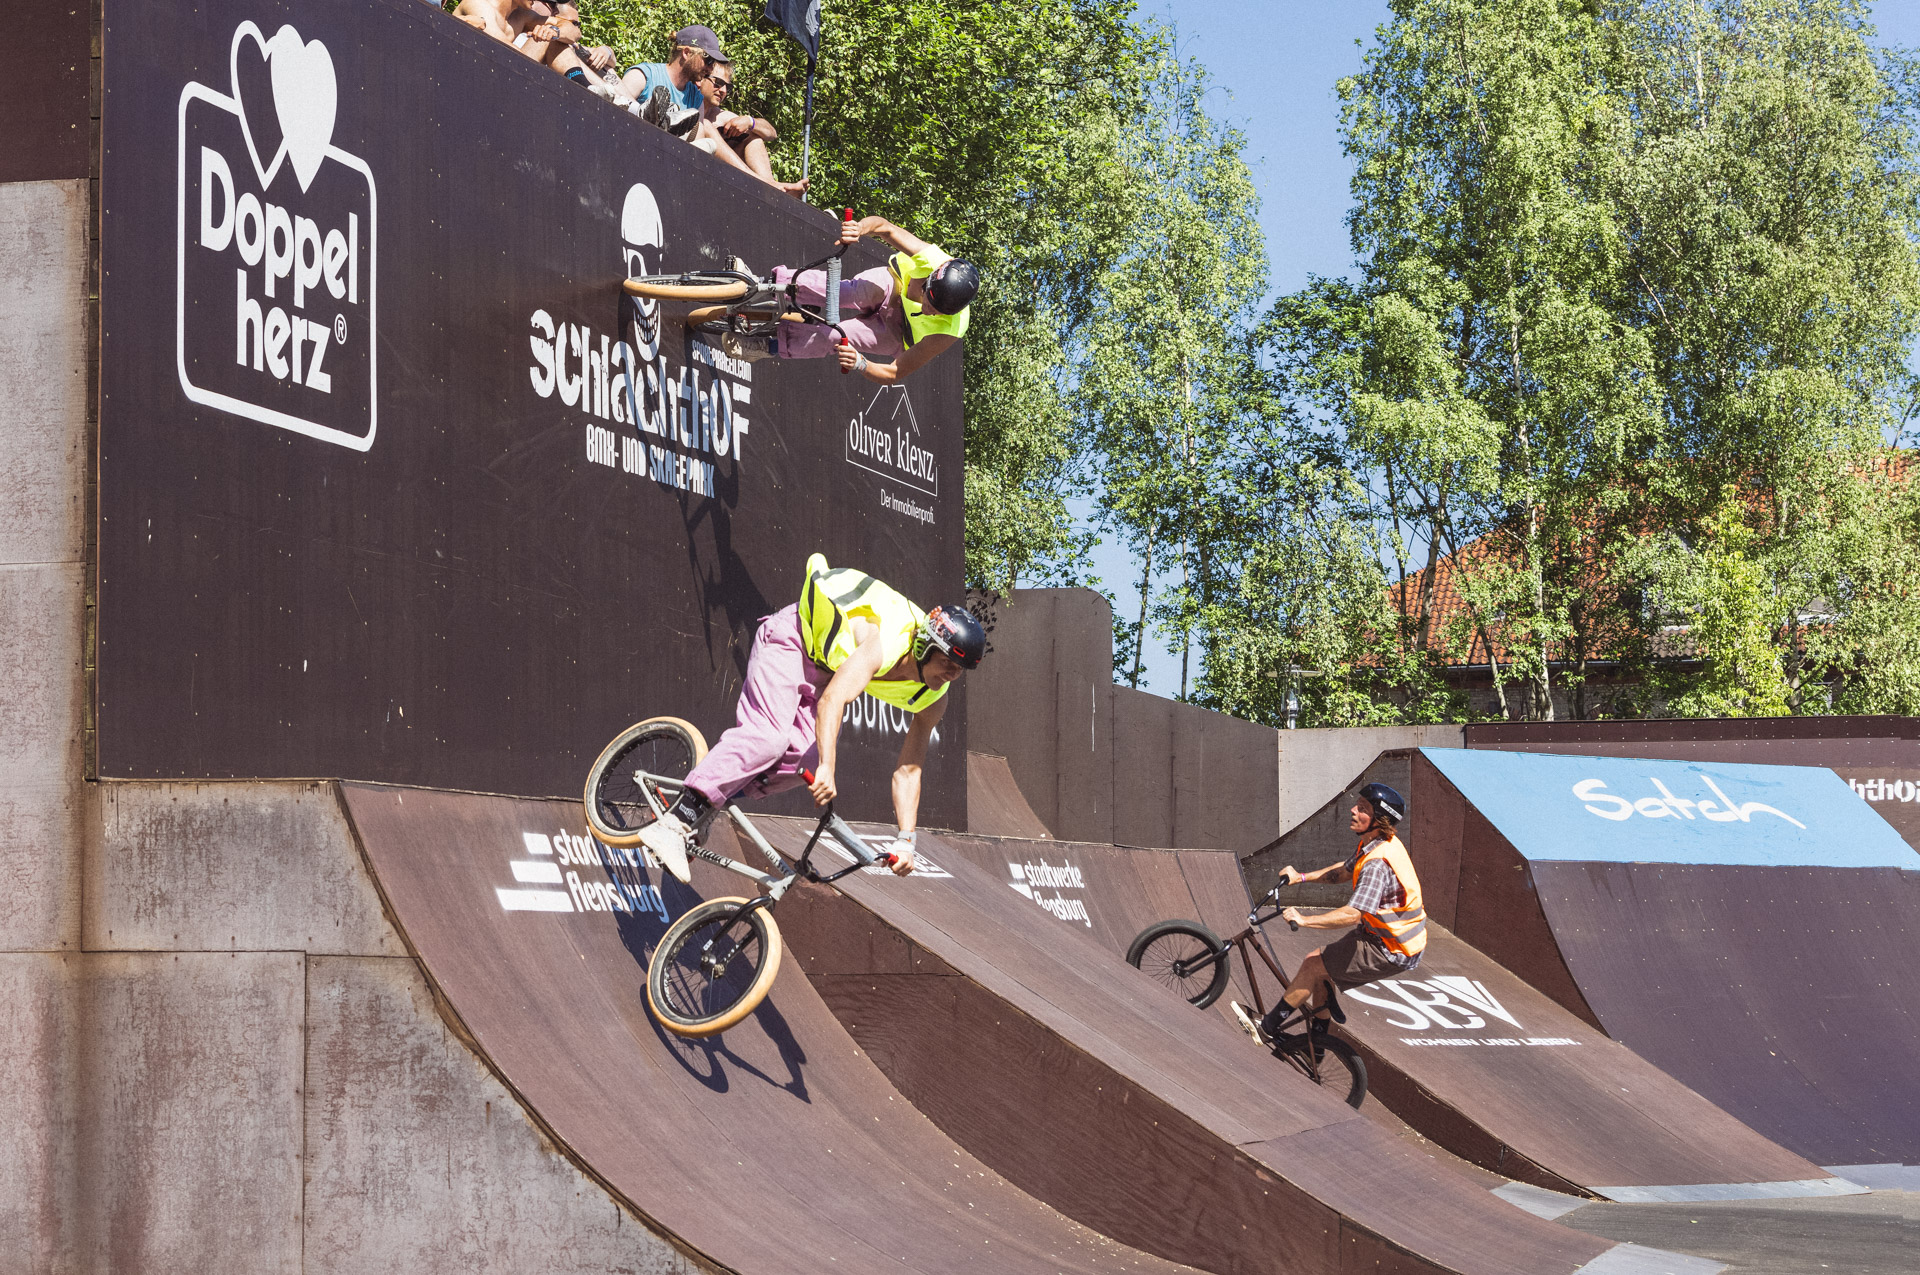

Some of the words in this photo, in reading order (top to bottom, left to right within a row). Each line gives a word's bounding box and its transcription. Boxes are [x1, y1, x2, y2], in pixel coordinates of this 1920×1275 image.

[200, 145, 358, 309] Doppel
[622, 435, 647, 477] UND
[880, 488, 892, 509] Der
[1024, 857, 1085, 889] stadtwerke
[565, 870, 670, 924] flensburg
[1399, 1037, 1480, 1047] WOHNEN
[1478, 1037, 1521, 1047] UND
